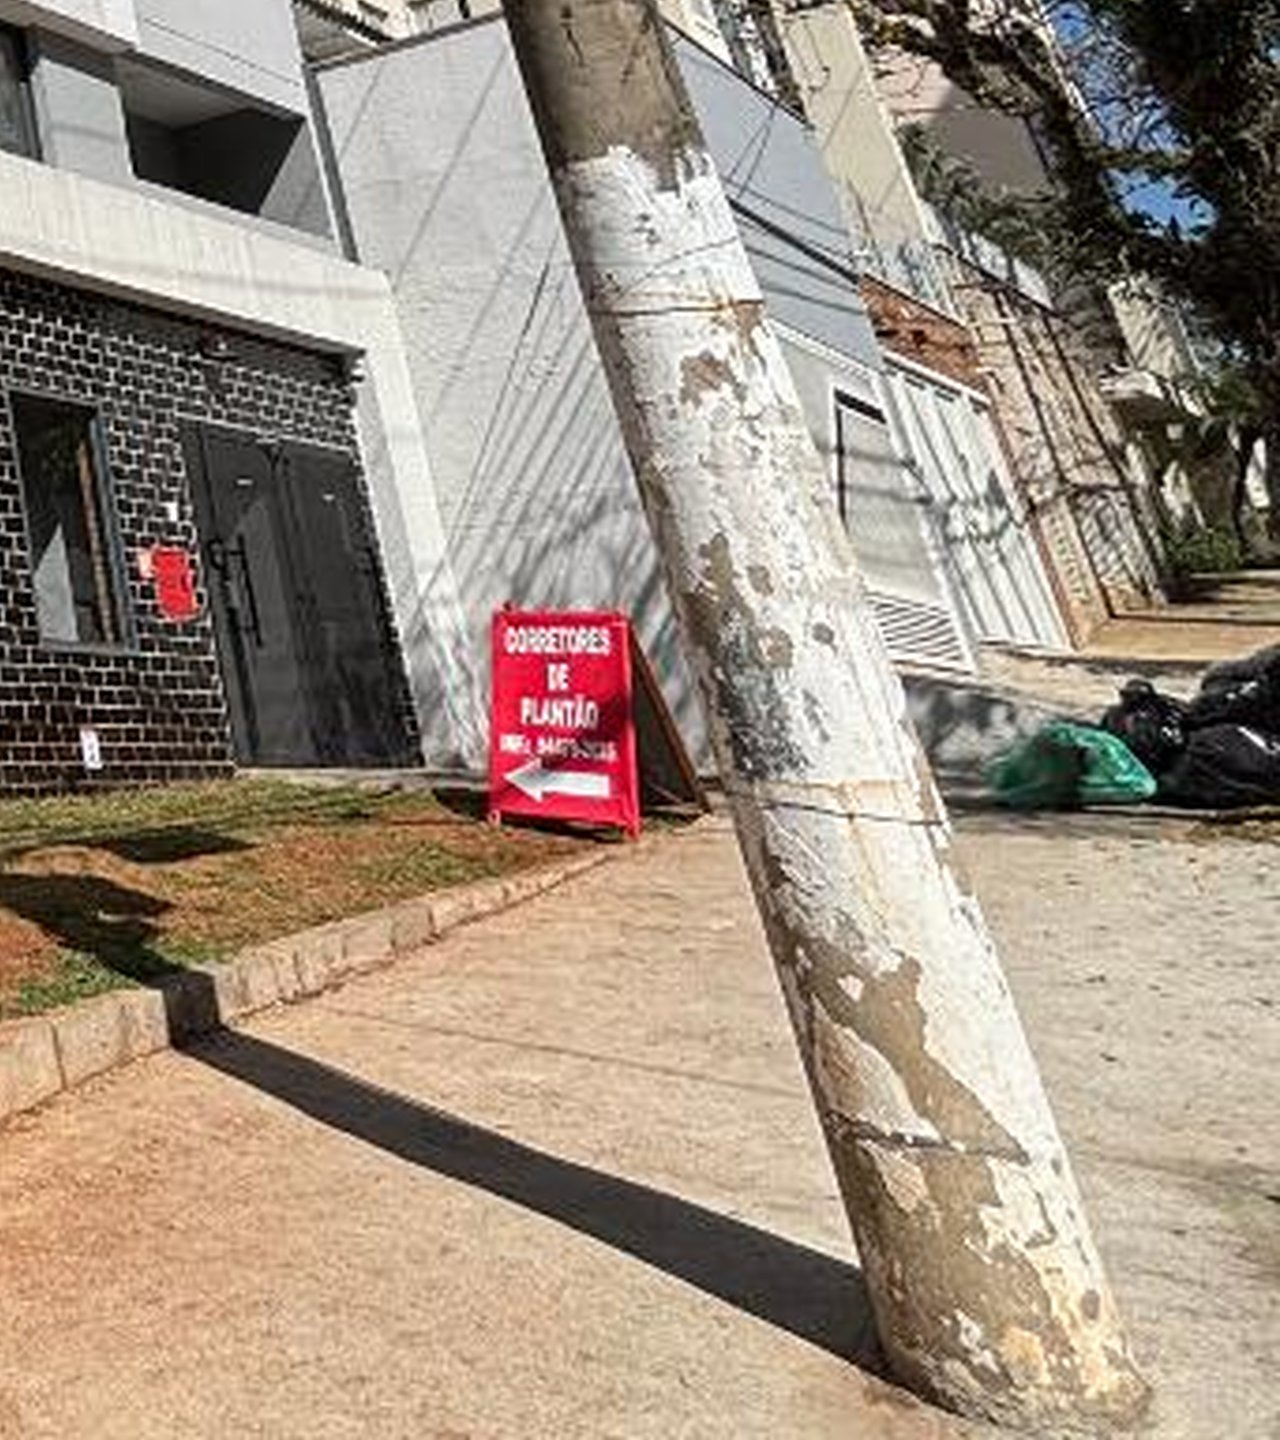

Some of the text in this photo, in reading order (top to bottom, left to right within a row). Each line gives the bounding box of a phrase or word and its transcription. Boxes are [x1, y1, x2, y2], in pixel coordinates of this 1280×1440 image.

[503, 625, 612, 657] CORRETORES
[547, 662, 570, 691] DE
[520, 693, 599, 730] PLANTÃO
